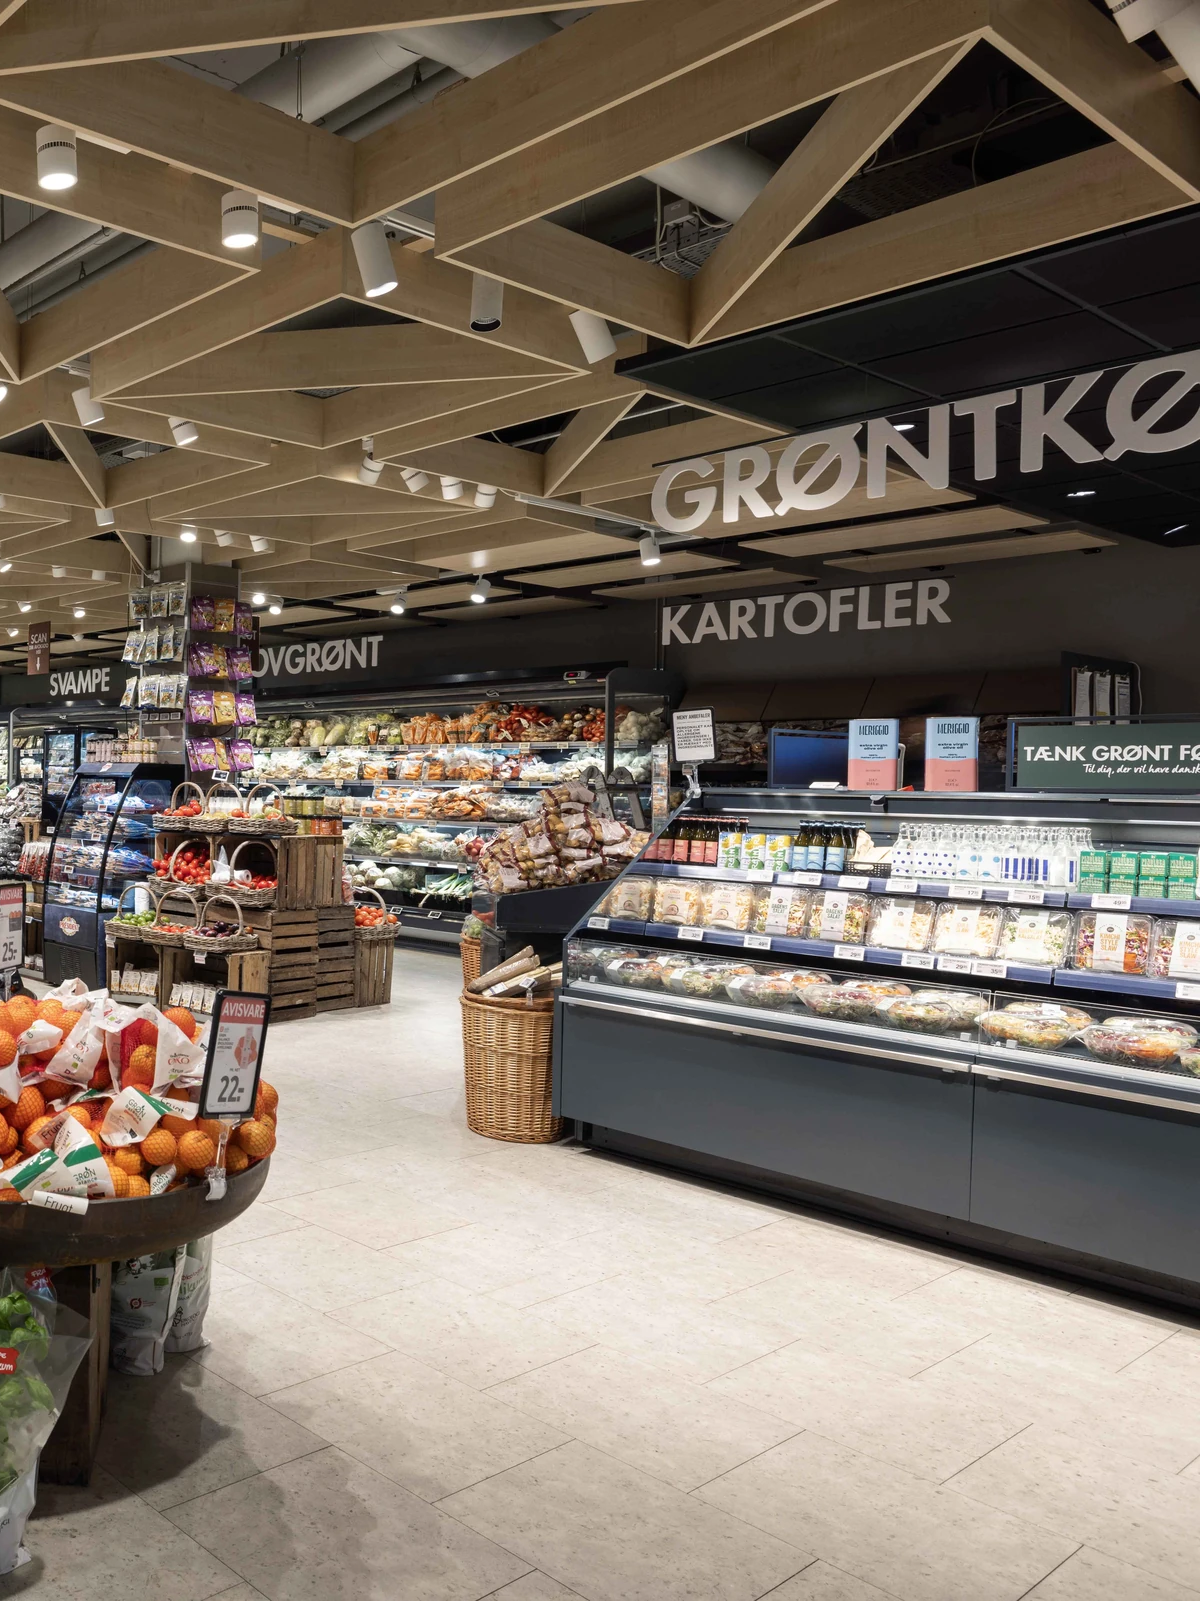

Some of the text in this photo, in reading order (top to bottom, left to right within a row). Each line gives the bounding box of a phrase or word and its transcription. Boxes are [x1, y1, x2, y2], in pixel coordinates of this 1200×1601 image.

[662, 578, 952, 646] KARTOFLER
[31, 633, 47, 644] SCAN
[251, 635, 384, 678] OVGRØNT
[49, 667, 111, 697] SVAMPE
[1024, 746, 1086, 761] TÆNK
[1092, 744, 1173, 761] GRØNT
[1083, 763, 1096, 773] Til
[1117, 763, 1132, 773] der
[1134, 763, 1148, 773] vil
[1149, 763, 1170, 773] have
[0, 889, 23, 900] AVISVARE
[222, 1002, 265, 1018] AVISVARE
